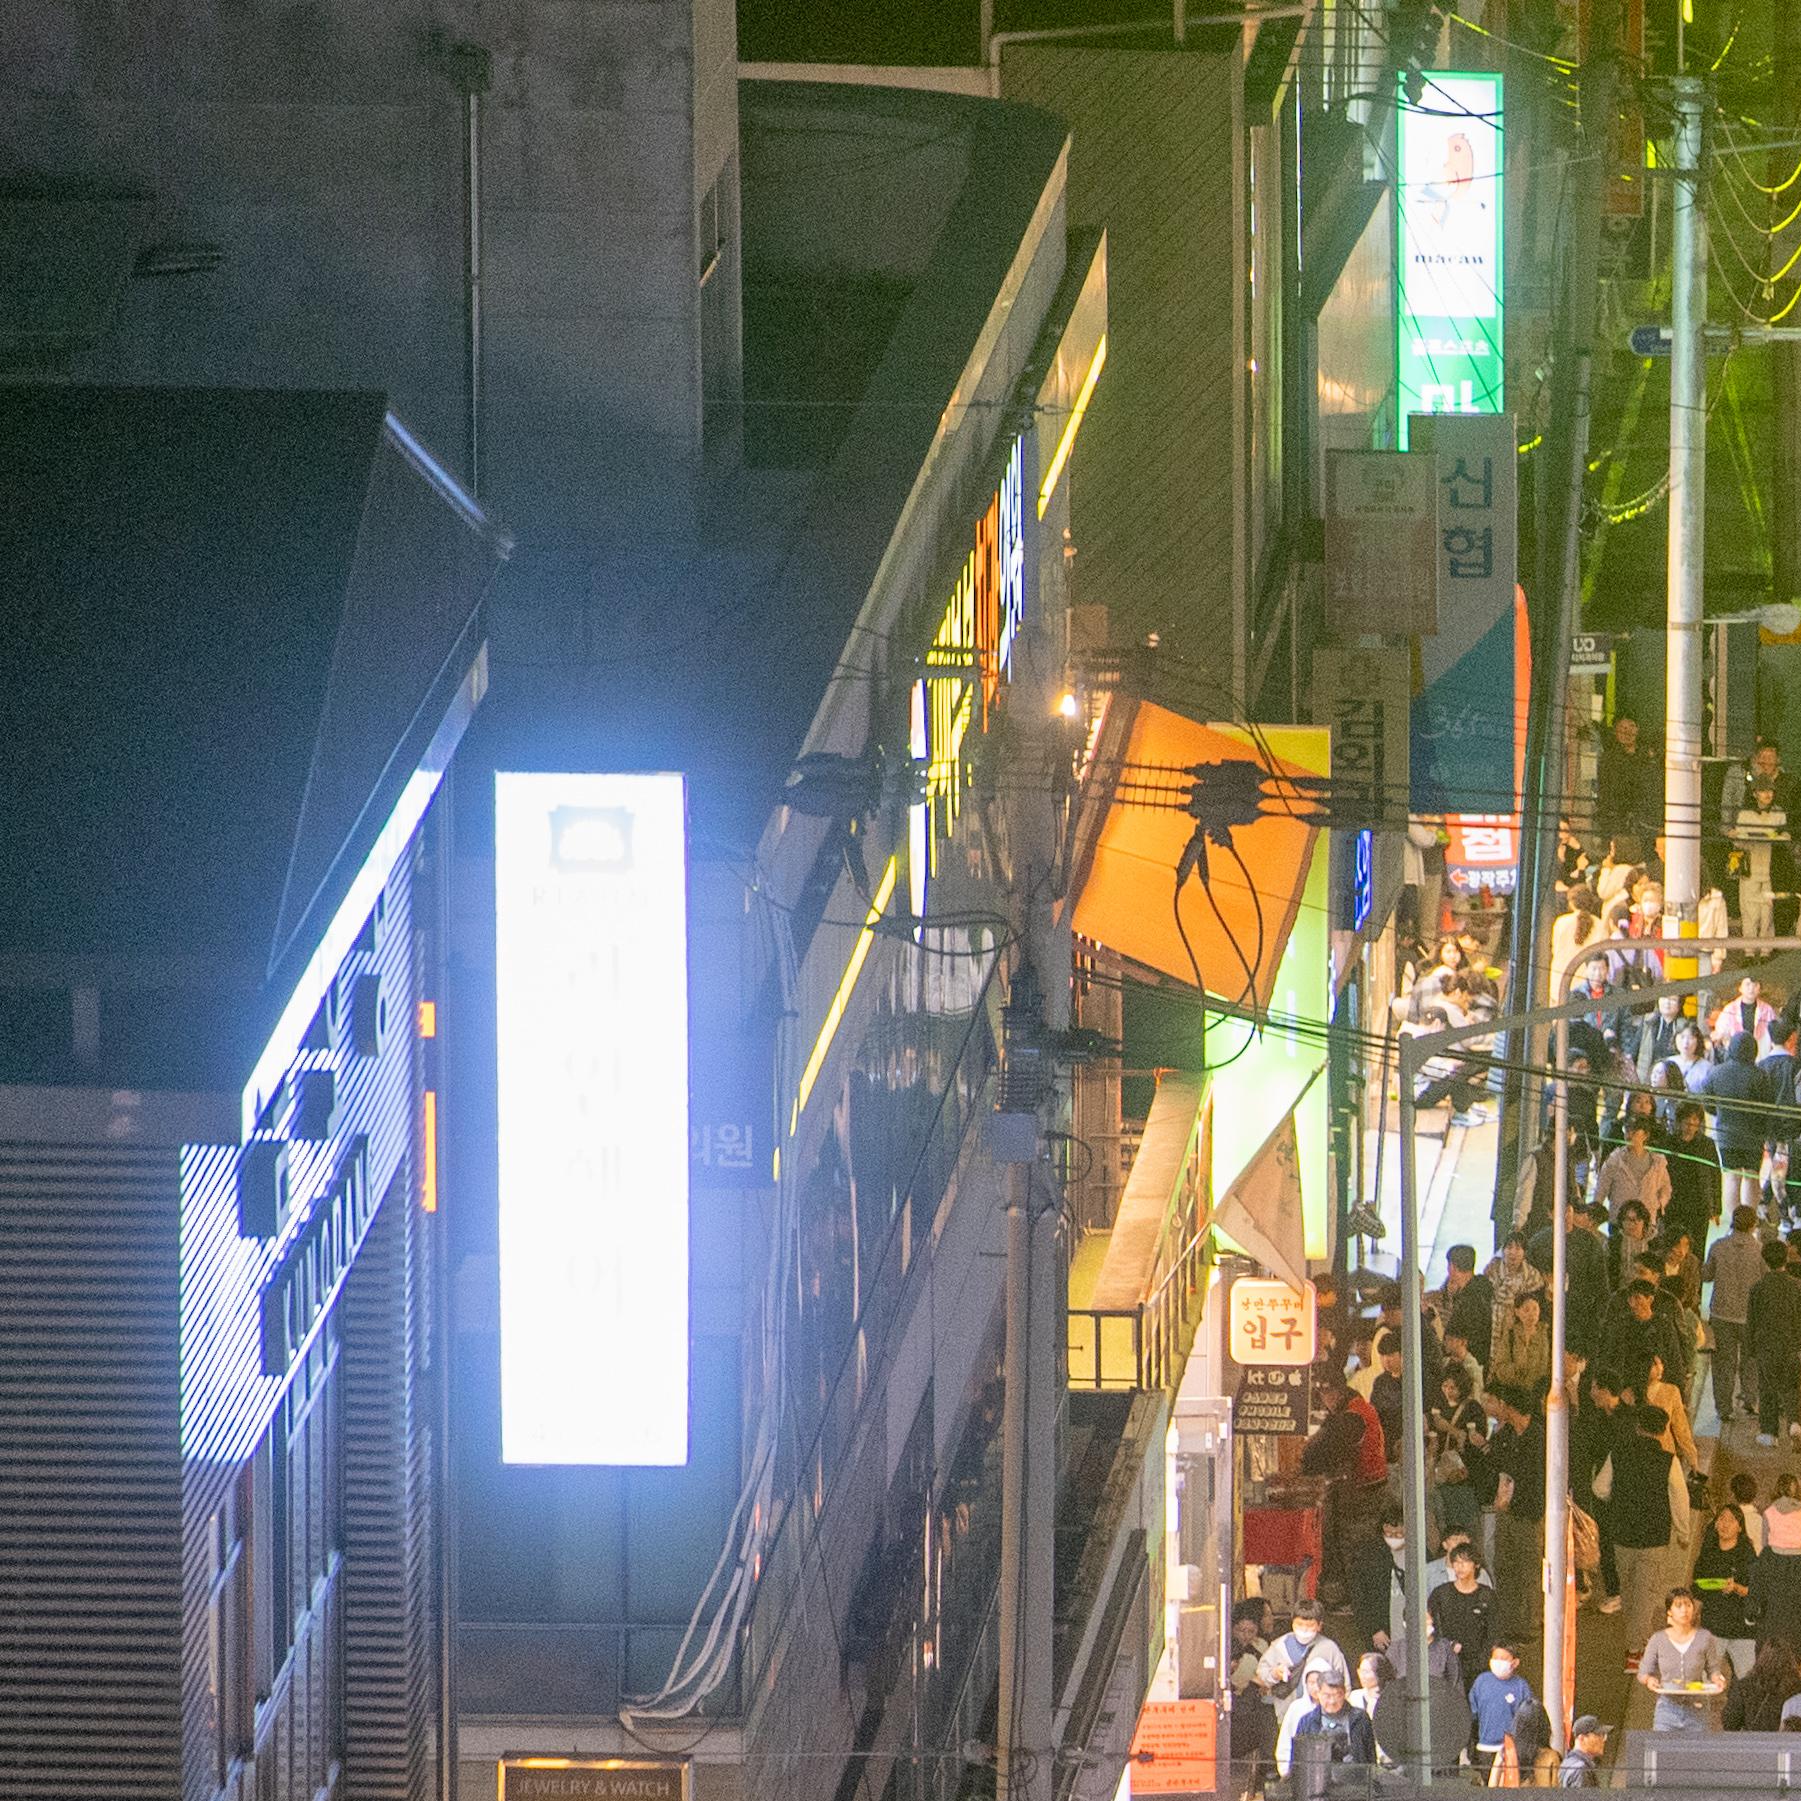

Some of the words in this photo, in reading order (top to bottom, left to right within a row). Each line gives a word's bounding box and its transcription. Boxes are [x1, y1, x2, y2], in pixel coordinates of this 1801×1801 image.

[1441, 455, 1493, 581] 신협
[1243, 1315, 1304, 1351] 입구
[516, 1779, 590, 1798] JEWELRY
[594, 1780, 607, 1797] &
[609, 1779, 671, 1797] WATCH
